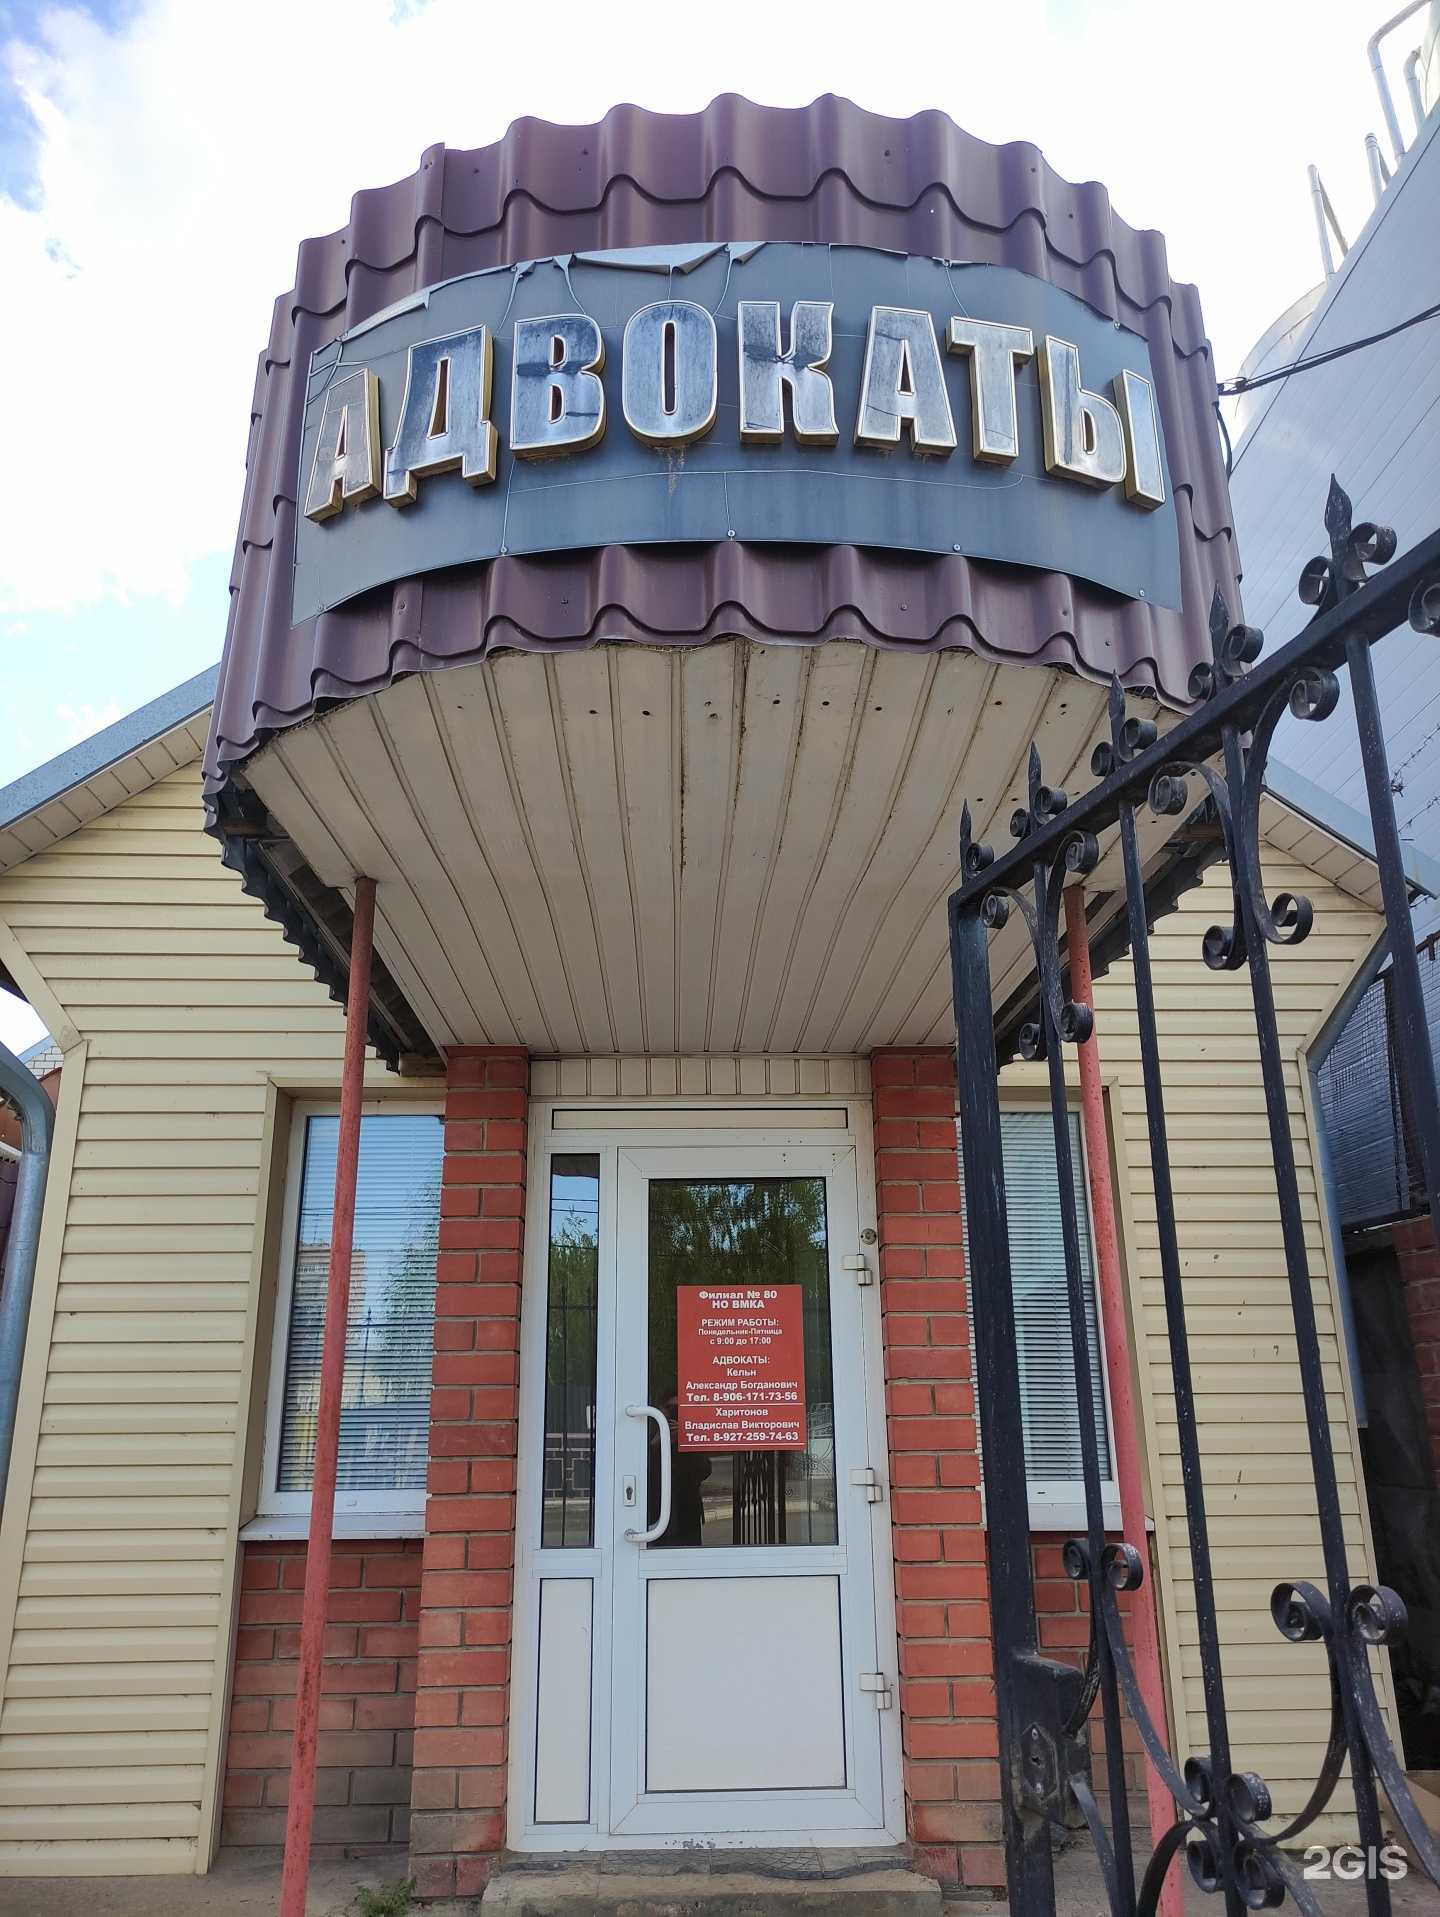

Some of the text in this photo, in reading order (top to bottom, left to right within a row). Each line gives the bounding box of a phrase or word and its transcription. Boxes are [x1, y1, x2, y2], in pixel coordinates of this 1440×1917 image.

[304, 299, 1167, 524] АДВОКАТЫ
[699, 1291, 743, 1299] Филиал
[747, 1290, 760, 1298] №
[733, 1300, 764, 1308] ВМКА
[712, 1356, 770, 1365] АДВОКАТЫ:
[686, 1381, 797, 1391] Александр Богданович
[687, 1392, 797, 1401] Тел. 8-906-171-73-56
[715, 1408, 768, 1417] Харитонов
[685, 1421, 799, 1430] Владислав Викторович
[687, 1432, 798, 1441] Тел. 8-927-259-74-63
